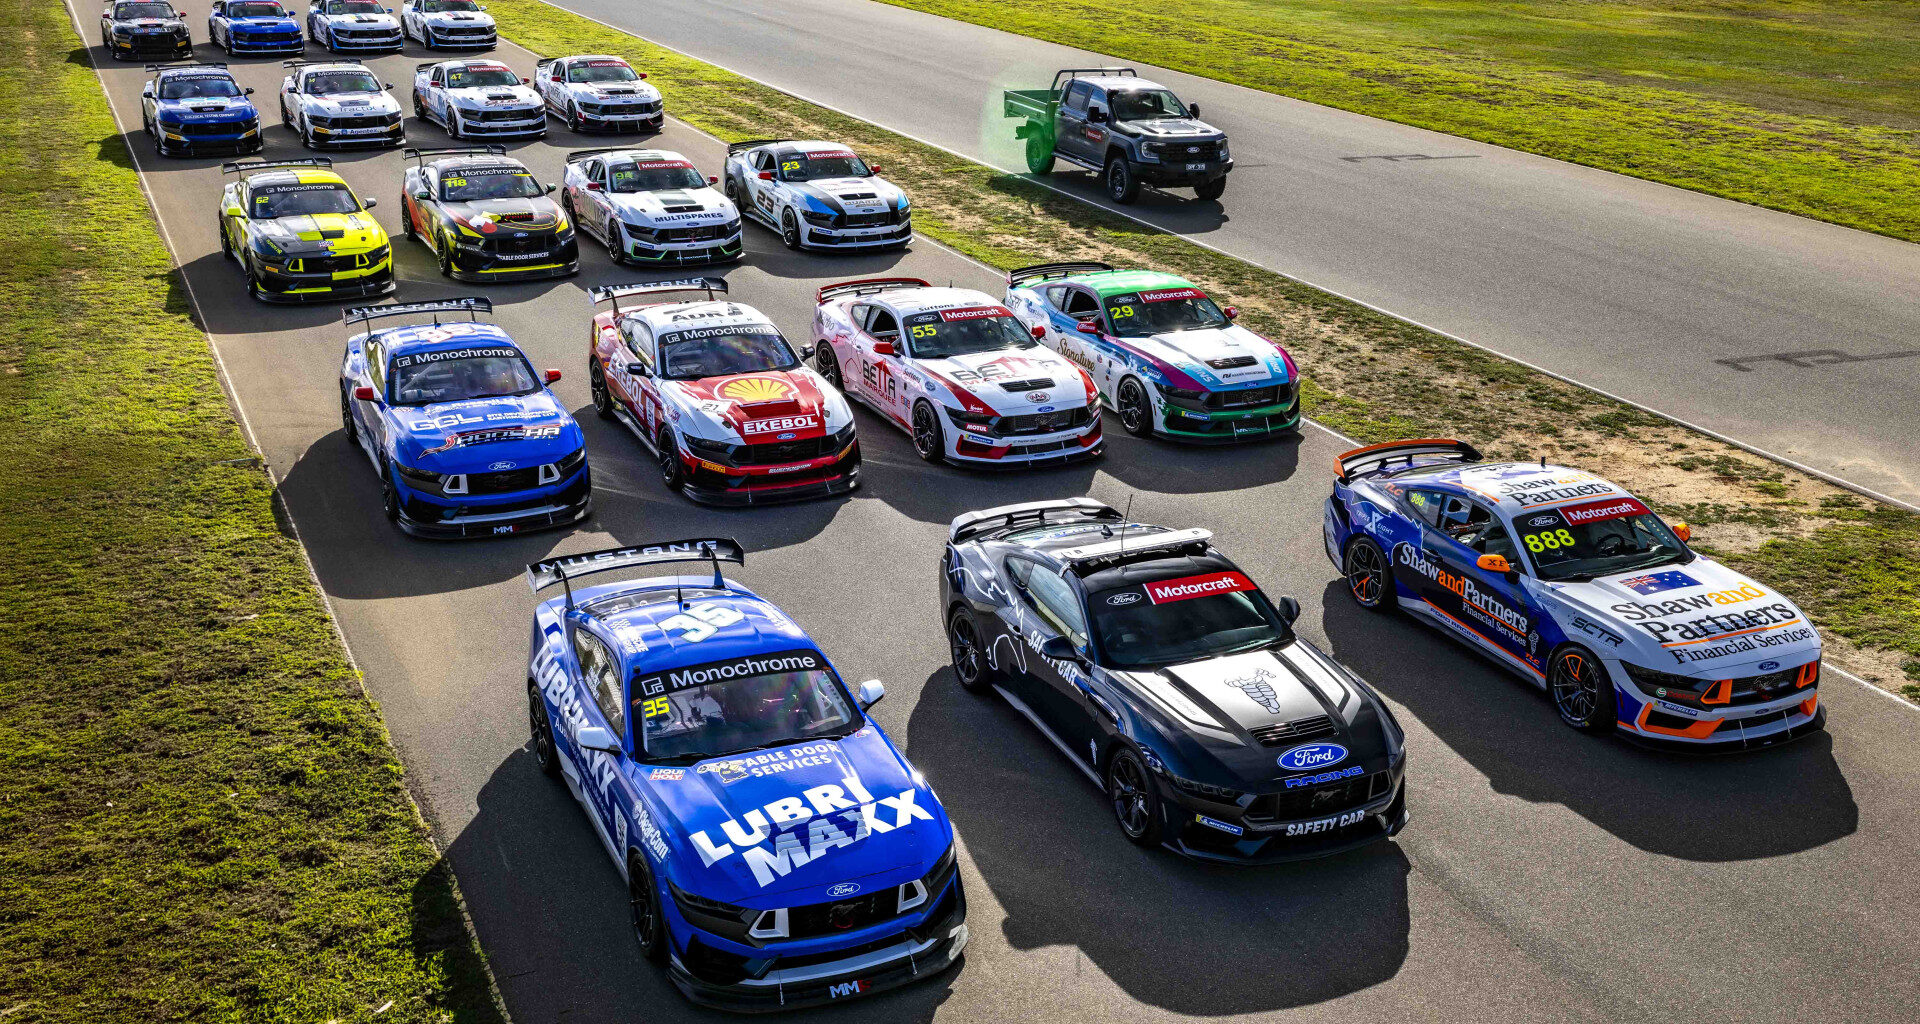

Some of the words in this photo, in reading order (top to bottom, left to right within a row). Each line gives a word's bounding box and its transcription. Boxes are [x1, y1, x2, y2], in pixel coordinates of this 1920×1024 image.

[460, 168, 523, 177] Monochrome
[782, 161, 800, 171] 23
[277, 184, 335, 193] Monochrome
[446, 179, 467, 188] 118
[755, 189, 774, 215] 23
[655, 212, 724, 223] MULTISPARES
[1144, 289, 1196, 301] Motorcraft
[351, 298, 476, 315] MUSTANG
[918, 303, 955, 311] Suttons
[945, 307, 1001, 319] Motorcraft
[1110, 305, 1135, 320] 29
[683, 323, 775, 340] Monochrome
[912, 324, 937, 338] 55
[415, 347, 515, 365] Monochrome
[1057, 338, 1096, 373] Signature
[863, 378, 897, 407] MARQUEE
[410, 413, 484, 432] GGL
[743, 415, 818, 433] EKEBOL
[966, 423, 987, 431] MOTUL
[1384, 482, 1404, 496] TLC
[1507, 481, 1614, 507] Partners
[1410, 492, 1426, 506] 888
[1534, 516, 1554, 526] Ford
[1568, 502, 1638, 522] Motorcraft
[1377, 523, 1394, 536] EIGHT
[1524, 528, 1576, 553] 888
[539, 540, 717, 574] MUSTANG
[1155, 575, 1240, 599] Motorcraft
[1115, 594, 1136, 606] Ford
[1462, 600, 1495, 629] Financial
[1495, 619, 1527, 647] Services
[1571, 617, 1624, 648] SCTR
[1636, 602, 1797, 644] Partners
[1669, 638, 1755, 666] Financial
[1755, 627, 1814, 649] Services
[670, 653, 816, 688] Monochrome
[1057, 660, 1079, 686] CAR
[642, 697, 671, 718] 35
[1664, 703, 1698, 716] MICHELIN
[745, 750, 788, 768] ABLE
[790, 742, 843, 757] DOOR
[1295, 747, 1335, 766] Ford
[753, 754, 833, 778] SERVICES
[1285, 765, 1364, 789] RACING
[688, 776, 875, 868] LUBRI
[1285, 816, 1338, 837] SAFETY
[1339, 809, 1366, 827] CAR
[742, 788, 935, 888] MAXX
[834, 884, 855, 895] Ford
